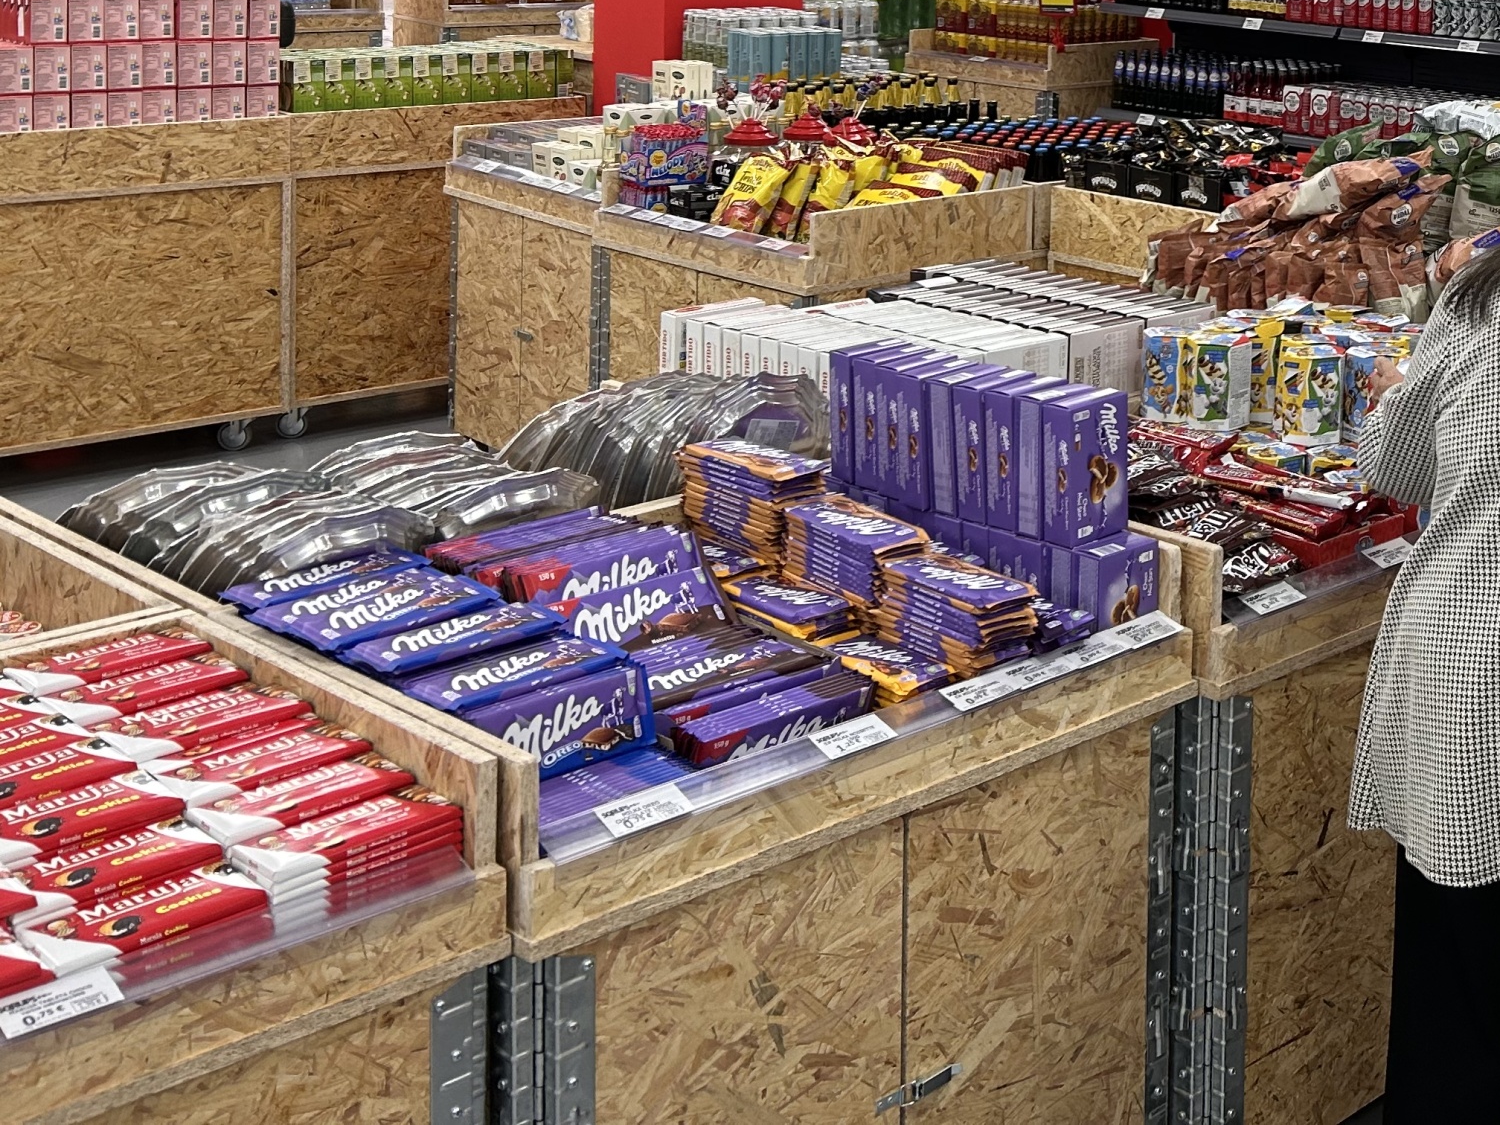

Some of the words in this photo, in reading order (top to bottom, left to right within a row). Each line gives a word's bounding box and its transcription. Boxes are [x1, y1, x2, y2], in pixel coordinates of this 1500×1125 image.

[1100, 403, 1120, 455] Milka
[330, 589, 424, 629] Milka
[574, 587, 673, 643] Milka
[392, 613, 493, 652] Milka
[651, 635, 675, 644] Noisette
[85, 660, 194, 693] Maruja
[452, 650, 551, 692] Milka
[648, 651, 746, 691] Milka
[500, 694, 604, 763] Milka
[544, 742, 581, 766] OREO
[1, 782, 120, 822] Maruja
[76, 794, 141, 817] Cookies
[286, 795, 400, 839] Maruja
[34, 830, 155, 873] Maruja
[110, 842, 177, 866] Cookies
[78, 876, 200, 923] Maruja
[155, 887, 222, 914] Cookies
